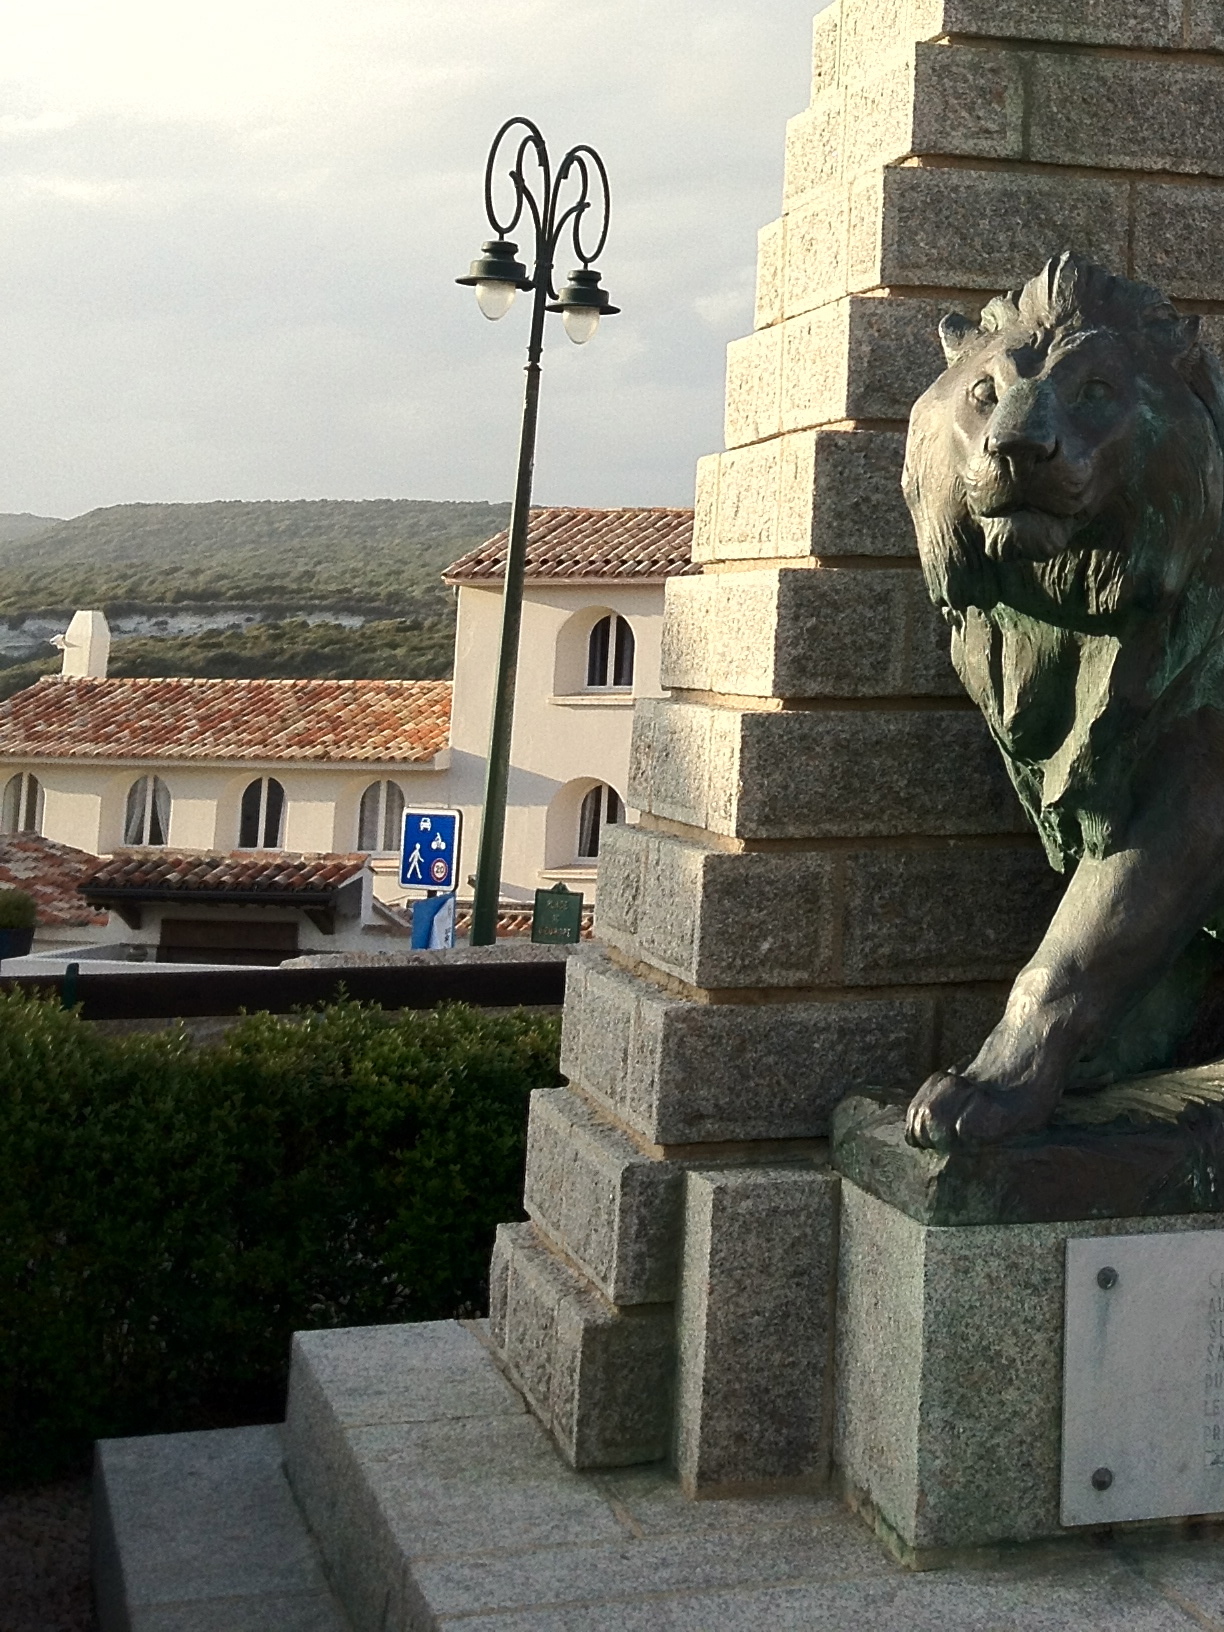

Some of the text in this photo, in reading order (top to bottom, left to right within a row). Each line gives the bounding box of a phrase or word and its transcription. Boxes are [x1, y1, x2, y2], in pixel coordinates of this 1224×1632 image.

[435, 865, 444, 874] 20
[1205, 1372, 1223, 1390] DU
[1204, 1399, 1220, 1416] LE
